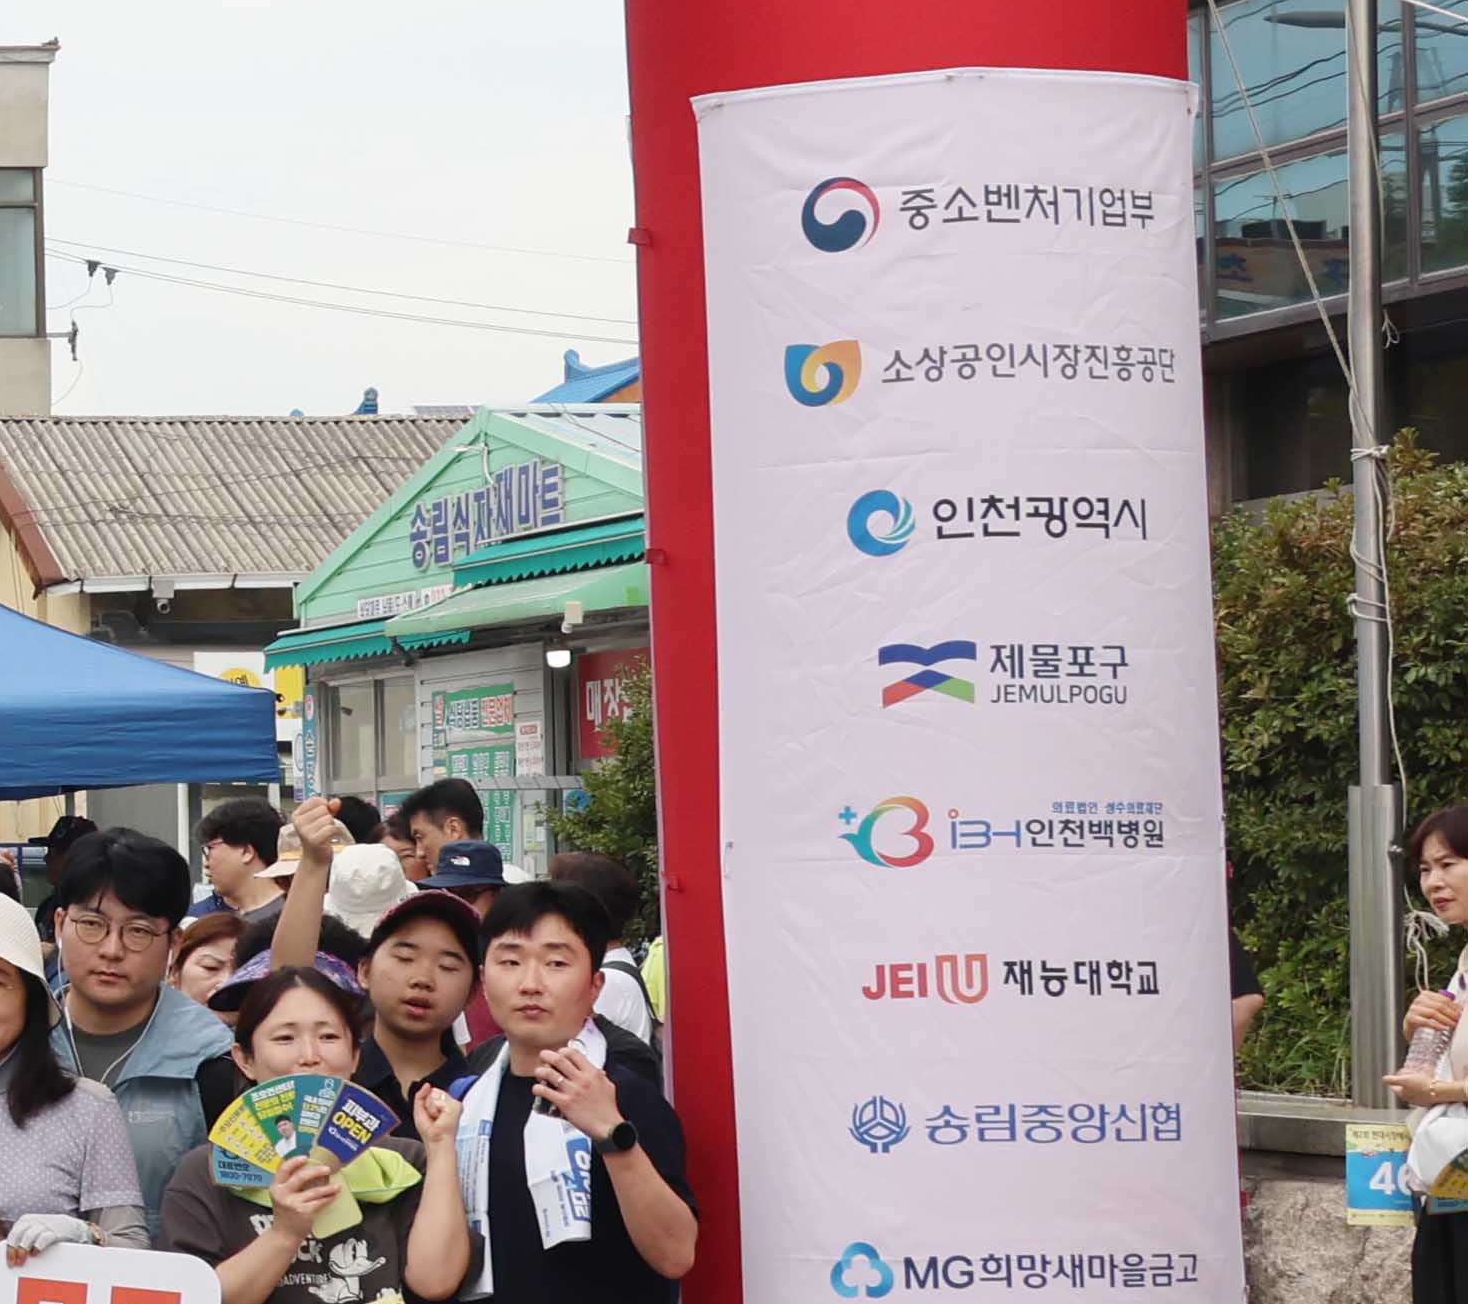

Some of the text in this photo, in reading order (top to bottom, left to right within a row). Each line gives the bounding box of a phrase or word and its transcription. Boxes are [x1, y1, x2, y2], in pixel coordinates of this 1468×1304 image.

[900, 185, 1154, 230] 중소벤처기업부
[882, 343, 1174, 383] 소상공인시장진흥공단
[410, 458, 563, 571] 송림식자재마트
[933, 495, 1146, 540] 인천광역시
[990, 645, 1128, 679] 제물포구
[991, 685, 1126, 704] JEMULPOGU
[1053, 802, 1097, 814] 의료법인
[1004, 960, 1159, 997] 재능대학교
[332, 1111, 373, 1145] OPEN
[341, 1098, 380, 1132] 피부과
[926, 1103, 1181, 1144] 송림중앙신협
[904, 1254, 1198, 1289] MG희망새마을금고
